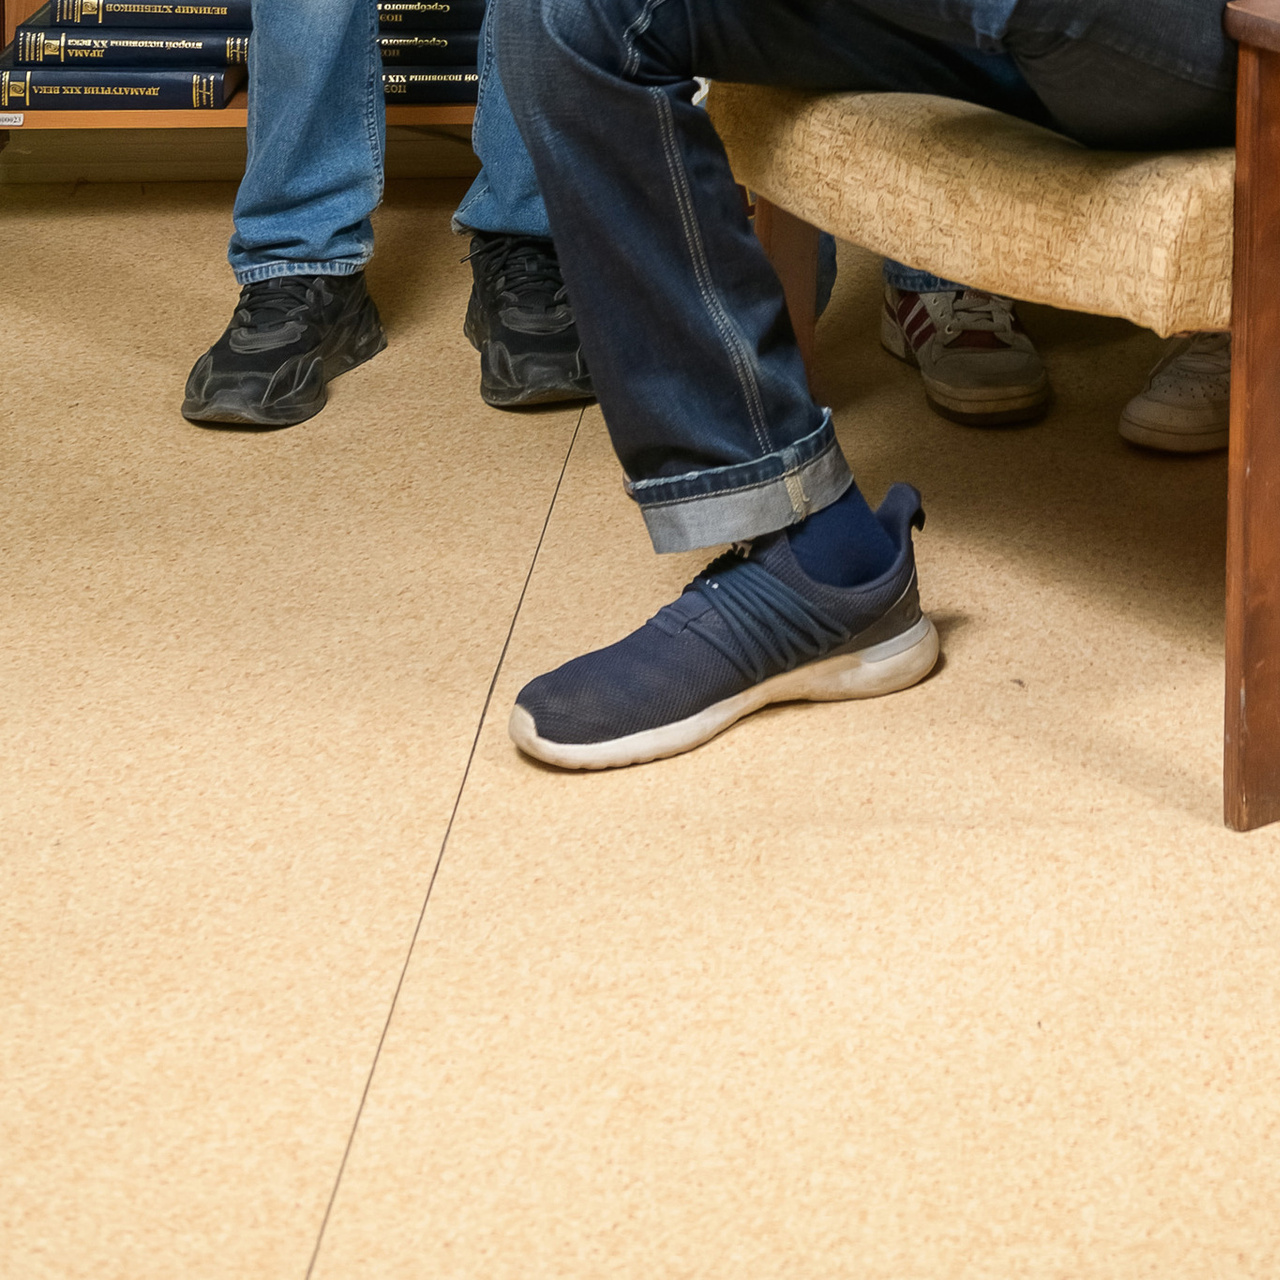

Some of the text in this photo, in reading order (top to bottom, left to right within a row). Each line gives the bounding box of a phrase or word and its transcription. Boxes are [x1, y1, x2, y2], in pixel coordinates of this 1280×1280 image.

[105, 3, 228, 15] ВЕЛИМИР ХЛЕБНИКОВ
[67, 48, 105, 58] ДРАМА
[32, 85, 161, 96] ДРАМАТУРГИЯ XIX ВЕКА
